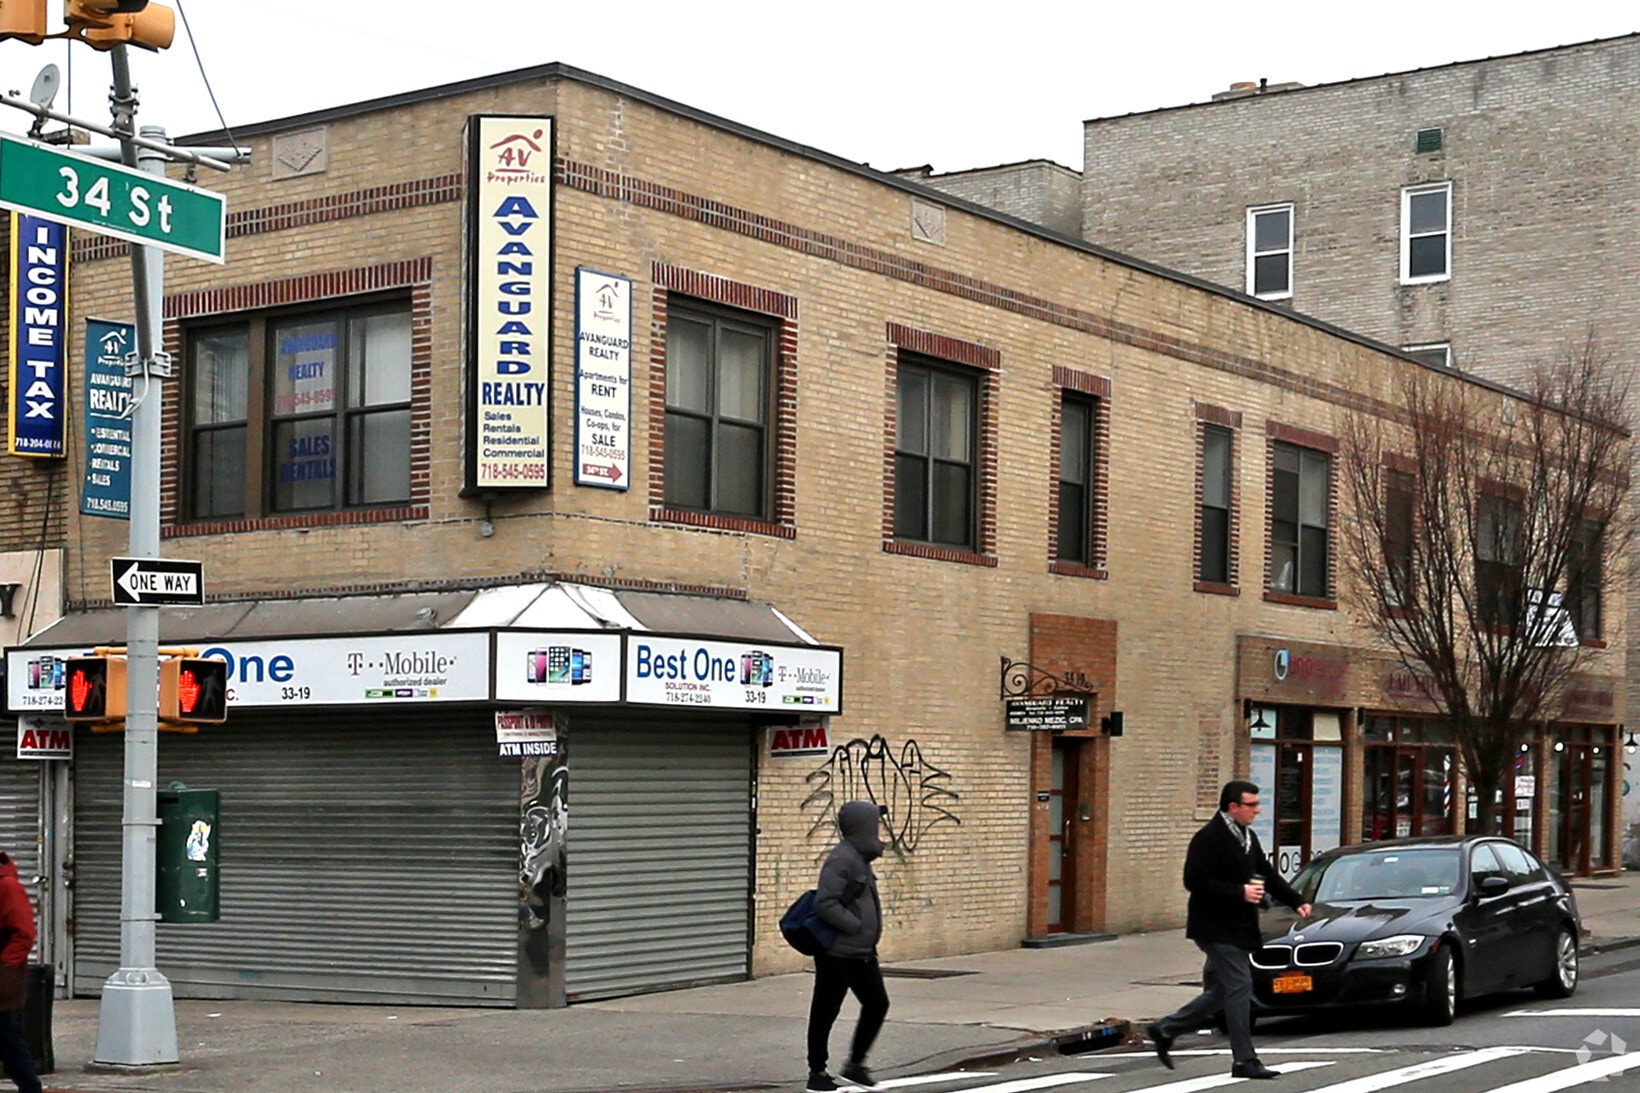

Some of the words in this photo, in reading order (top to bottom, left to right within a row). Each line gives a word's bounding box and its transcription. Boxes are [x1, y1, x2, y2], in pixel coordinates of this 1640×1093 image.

[487, 171, 545, 186] Properties
[56, 167, 111, 217] 34
[128, 186, 173, 234] St
[25, 227, 58, 346] INCOME
[492, 196, 540, 375] AVANGUARD
[579, 331, 630, 350] AVANGUARD
[588, 346, 620, 361] REALTY
[25, 360, 55, 419] TAX
[482, 382, 546, 407] REALTY
[591, 383, 618, 399] RENT
[484, 411, 512, 421] Sales
[483, 423, 522, 433] Rentals
[289, 434, 331, 459] SALES
[483, 436, 540, 446] Residential
[591, 433, 617, 448] SALE
[483, 448, 546, 458] Commercial
[481, 463, 546, 480] 718-545-0595
[129, 573, 158, 592] ONE
[164, 575, 191, 592] WAY
[637, 645, 688, 681] Best
[694, 648, 736, 682] One
[383, 677, 422, 687] authorized
[423, 677, 448, 686] dealer
[665, 682, 698, 691] SOLUTION
[281, 687, 311, 700] 33-19
[665, 692, 712, 704] 718-274-2240
[745, 690, 767, 704] 33-19
[20, 729, 71, 749] ATM
[771, 727, 828, 751] ATM
[499, 743, 521, 756] ATM
[522, 742, 558, 755] INSIDE
